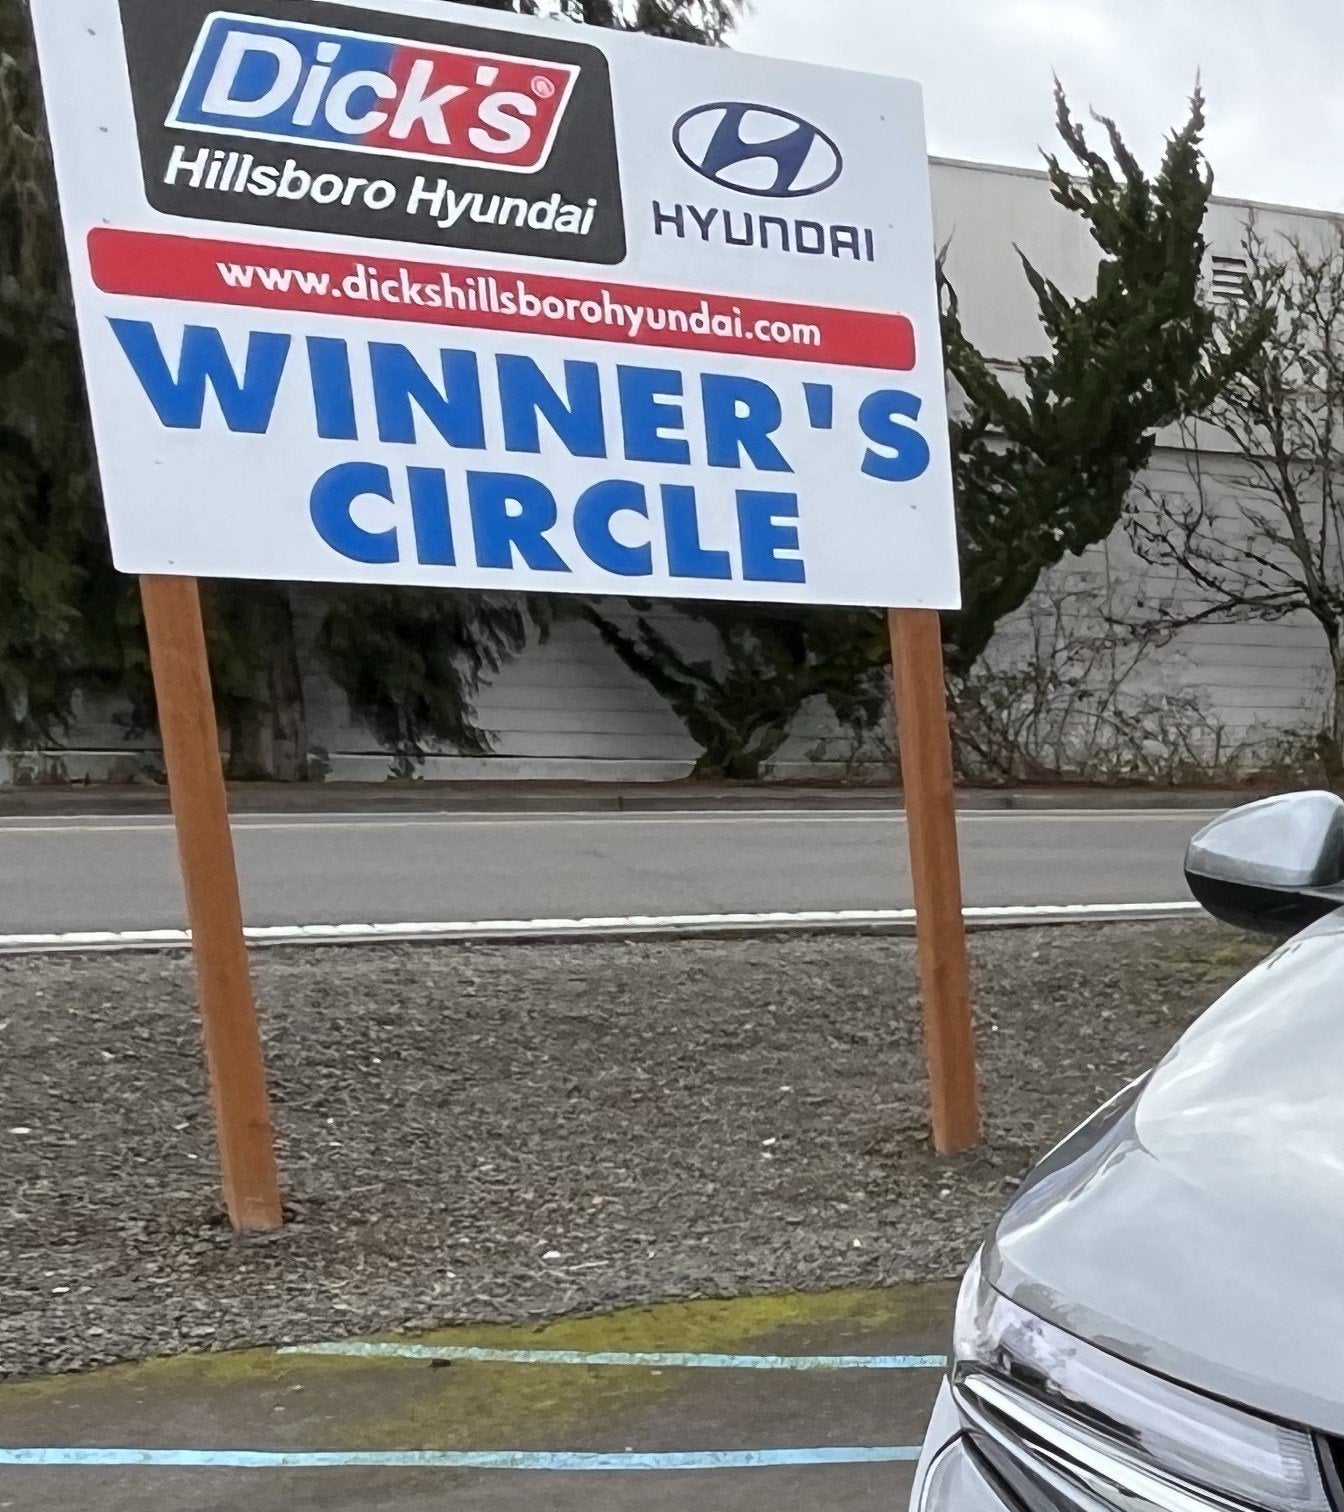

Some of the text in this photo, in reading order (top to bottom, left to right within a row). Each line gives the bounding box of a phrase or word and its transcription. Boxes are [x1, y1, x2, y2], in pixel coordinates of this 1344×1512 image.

[163, 144, 598, 237] Hillsboro Hyundai
[652, 200, 874, 263] HYUNDAI
[215, 260, 822, 349] www.dickshillsborohyundai.com
[105, 317, 932, 483] WINNER'S
[308, 461, 806, 584] CIRCLE
